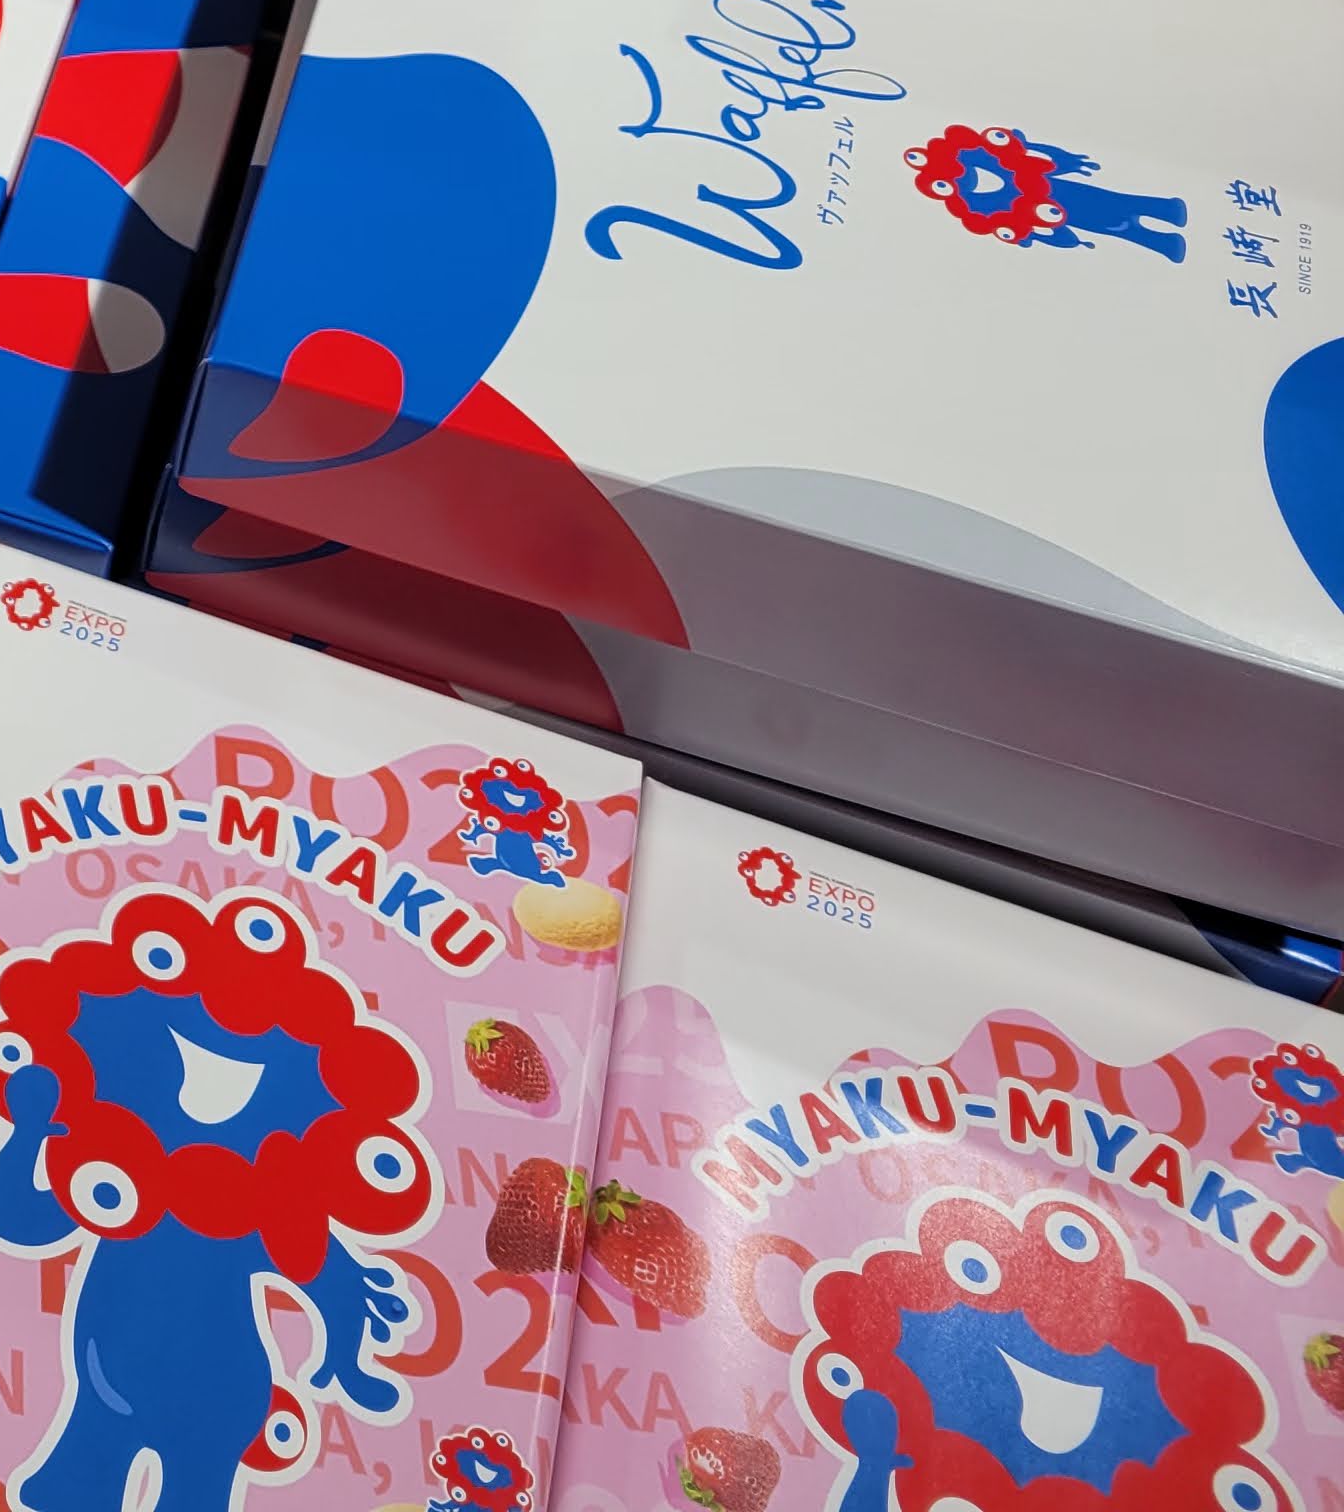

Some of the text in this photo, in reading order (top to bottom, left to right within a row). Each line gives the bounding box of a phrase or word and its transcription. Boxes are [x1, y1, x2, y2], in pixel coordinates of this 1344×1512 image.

[816, 114, 855, 227] ヴァッフェル
[1298, 223, 1312, 295] SINCE 1919
[59, 620, 121, 652] 2025
[64, 605, 126, 637] EXPO
[806, 894, 872, 929] 2025
[808, 876, 875, 912] EXPO
[701, 1072, 1318, 1278] MYAKU-MYAKU
